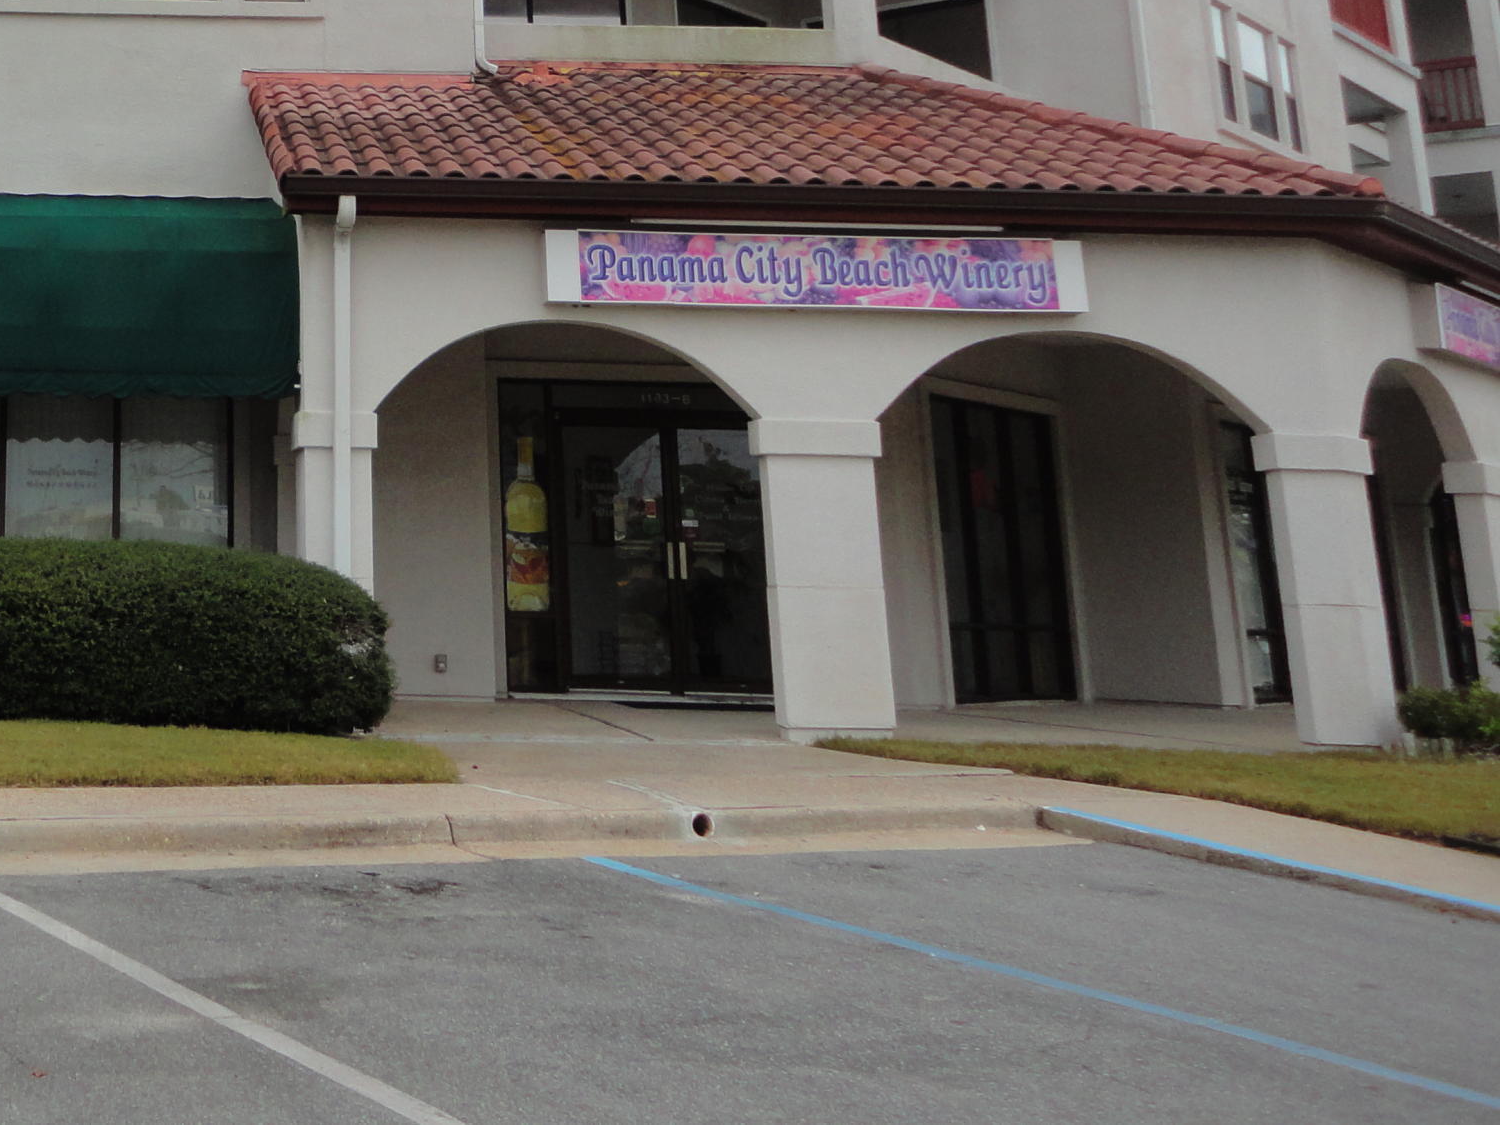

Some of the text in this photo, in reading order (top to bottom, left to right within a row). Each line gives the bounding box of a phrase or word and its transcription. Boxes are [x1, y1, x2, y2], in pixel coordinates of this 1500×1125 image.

[587, 244, 1047, 305] Panama City Beach Winery
